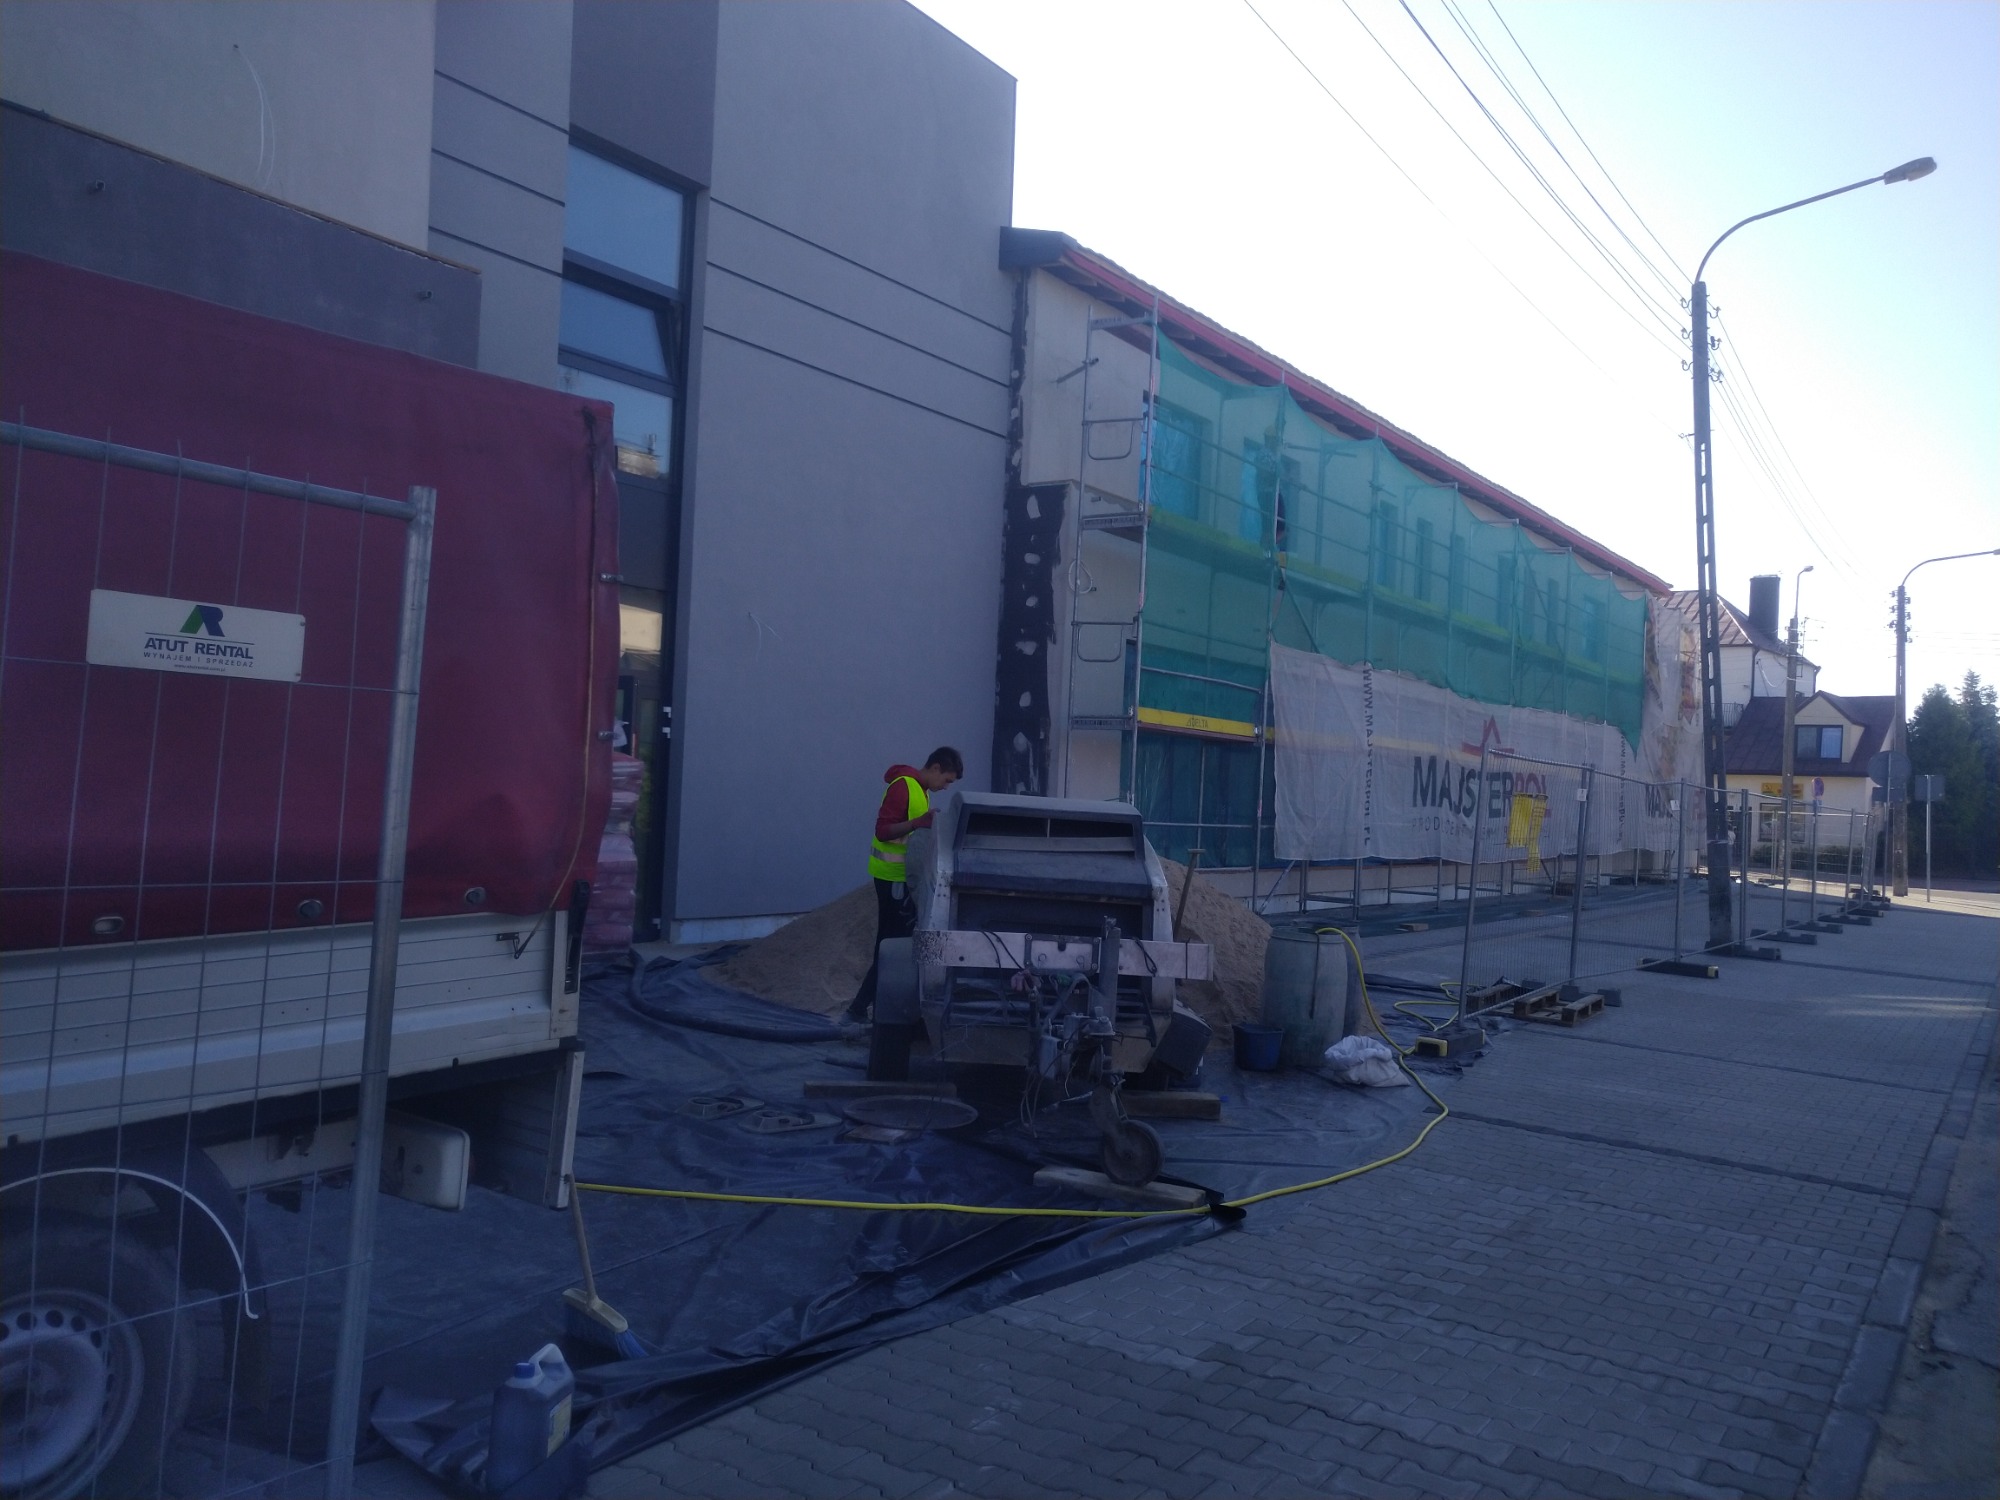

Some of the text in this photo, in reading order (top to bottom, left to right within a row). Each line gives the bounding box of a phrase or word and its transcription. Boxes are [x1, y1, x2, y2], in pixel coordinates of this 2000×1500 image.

[144, 637, 254, 660] ATUT RENTAL
[143, 652, 192, 662] WYNAJEM
